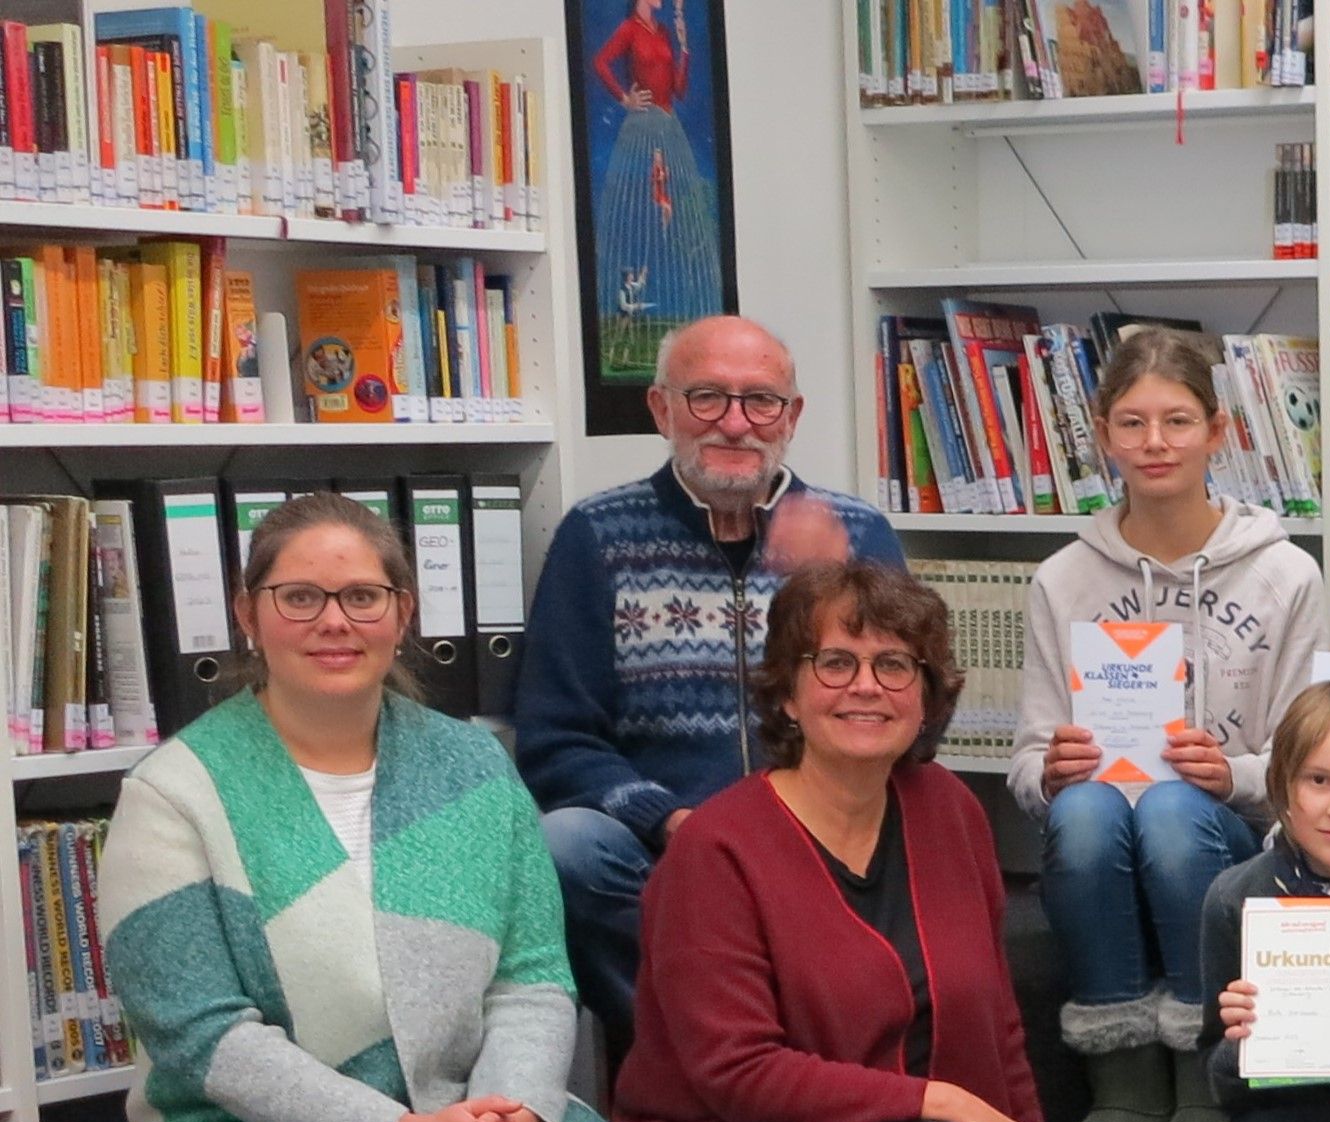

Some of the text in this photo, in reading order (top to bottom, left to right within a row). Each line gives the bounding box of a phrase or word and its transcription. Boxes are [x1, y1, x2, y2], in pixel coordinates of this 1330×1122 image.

[422, 504, 451, 515] OTTO
[1155, 586, 1270, 653] JERSEY
[1083, 670, 1129, 681] KLASSEN
[1101, 662, 1153, 674] URKUNDE
[52, 896, 68, 948] WORLD
[73, 900, 90, 949] WORLD
